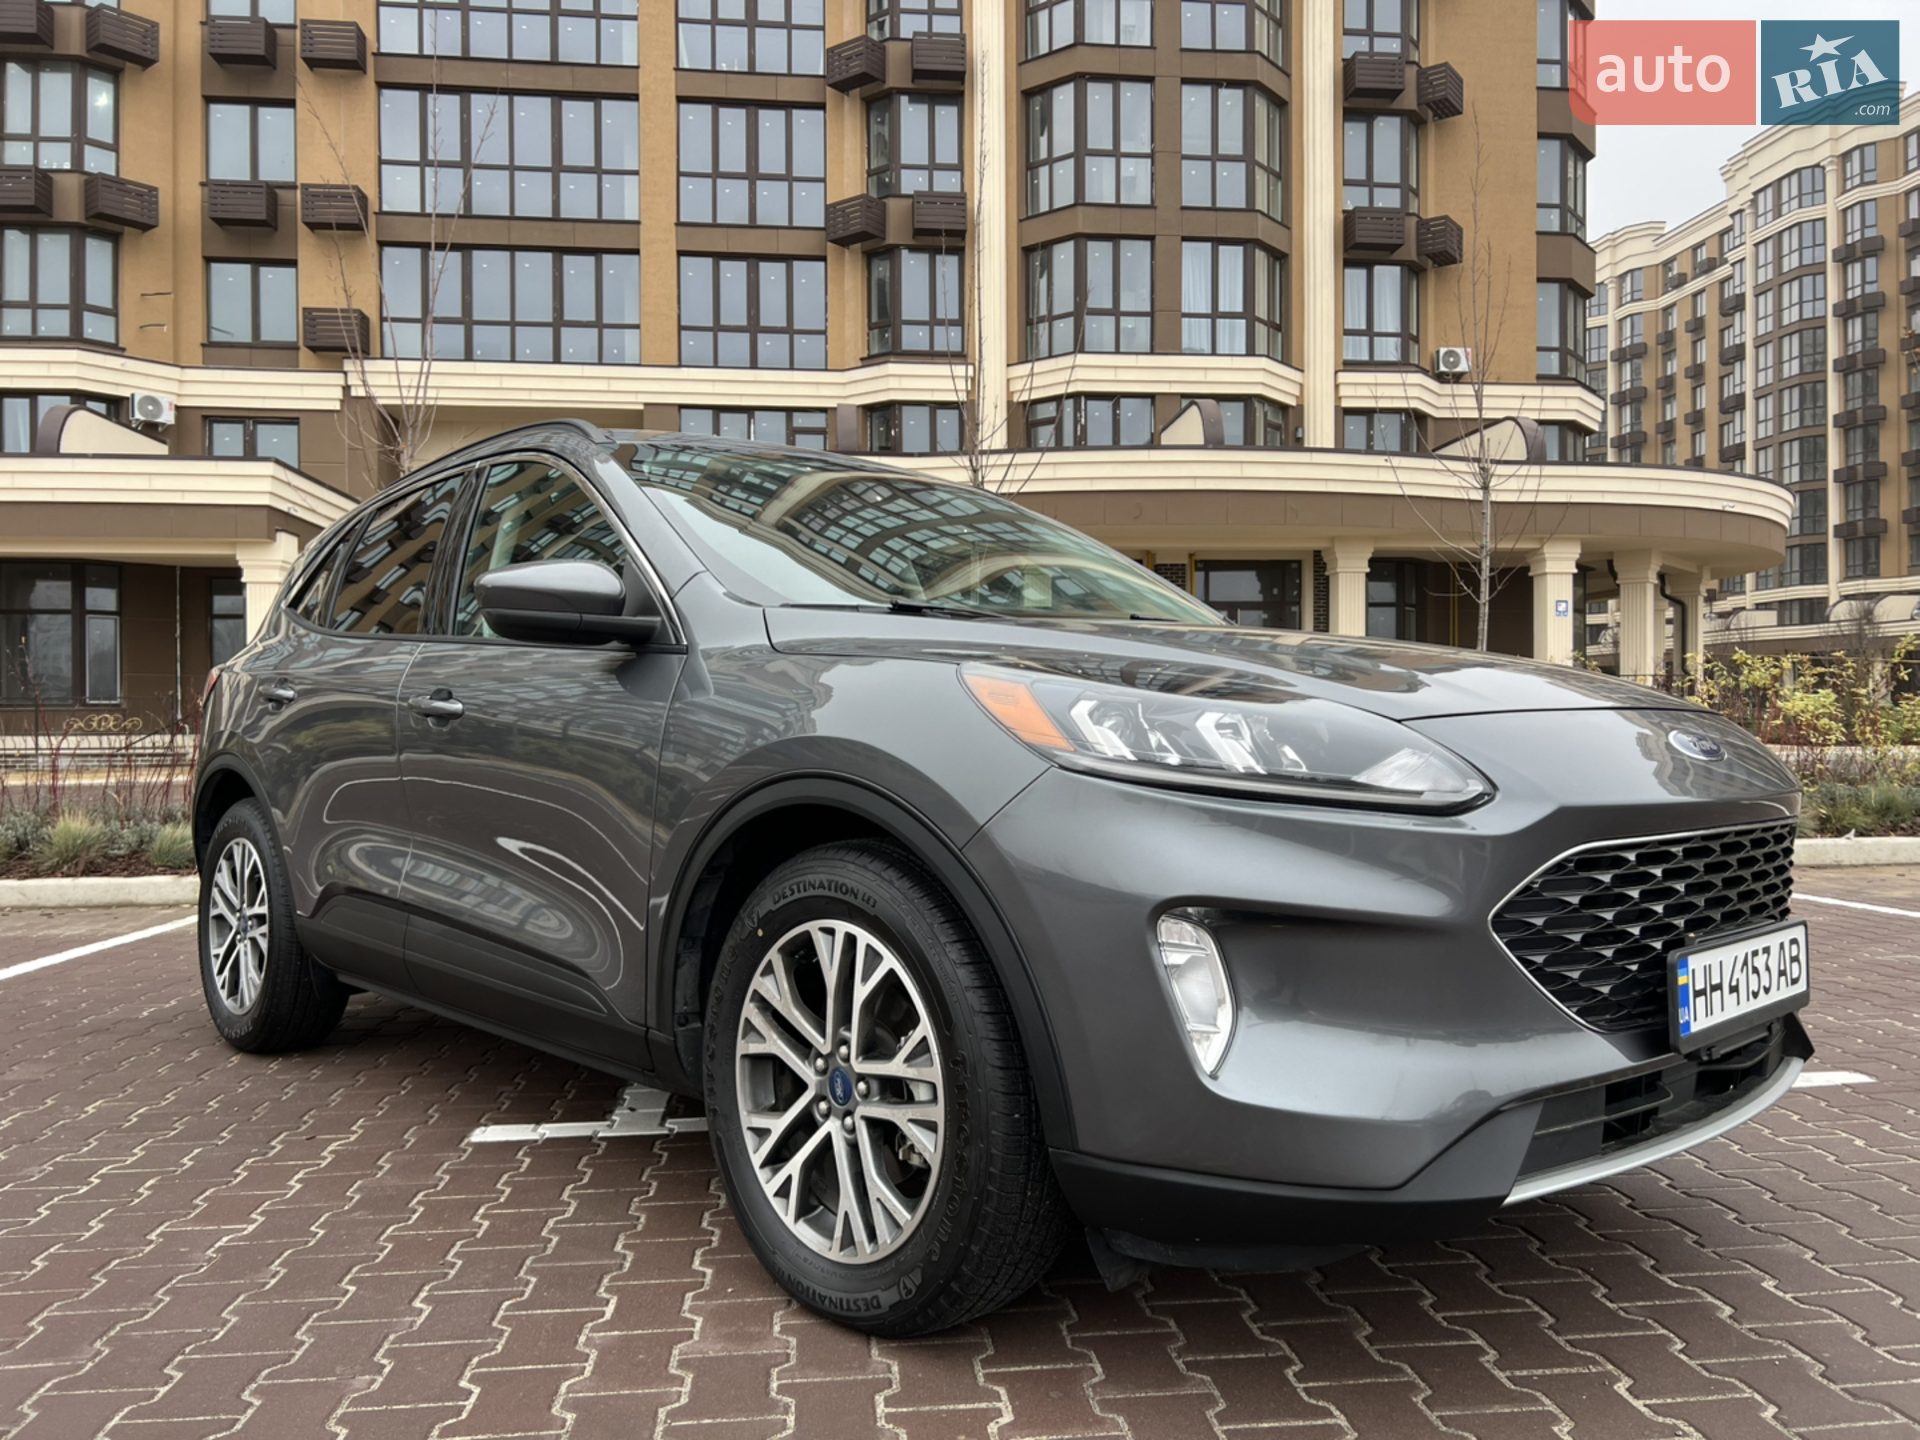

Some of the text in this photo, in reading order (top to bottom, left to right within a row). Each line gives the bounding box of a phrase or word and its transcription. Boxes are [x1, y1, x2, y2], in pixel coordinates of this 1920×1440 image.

[773, 880, 878, 909] DESTINATION LE3
[1728, 945, 1773, 1007] 4153
[1776, 937, 1803, 992] AB
[787, 1273, 882, 1312] DESTINATION
